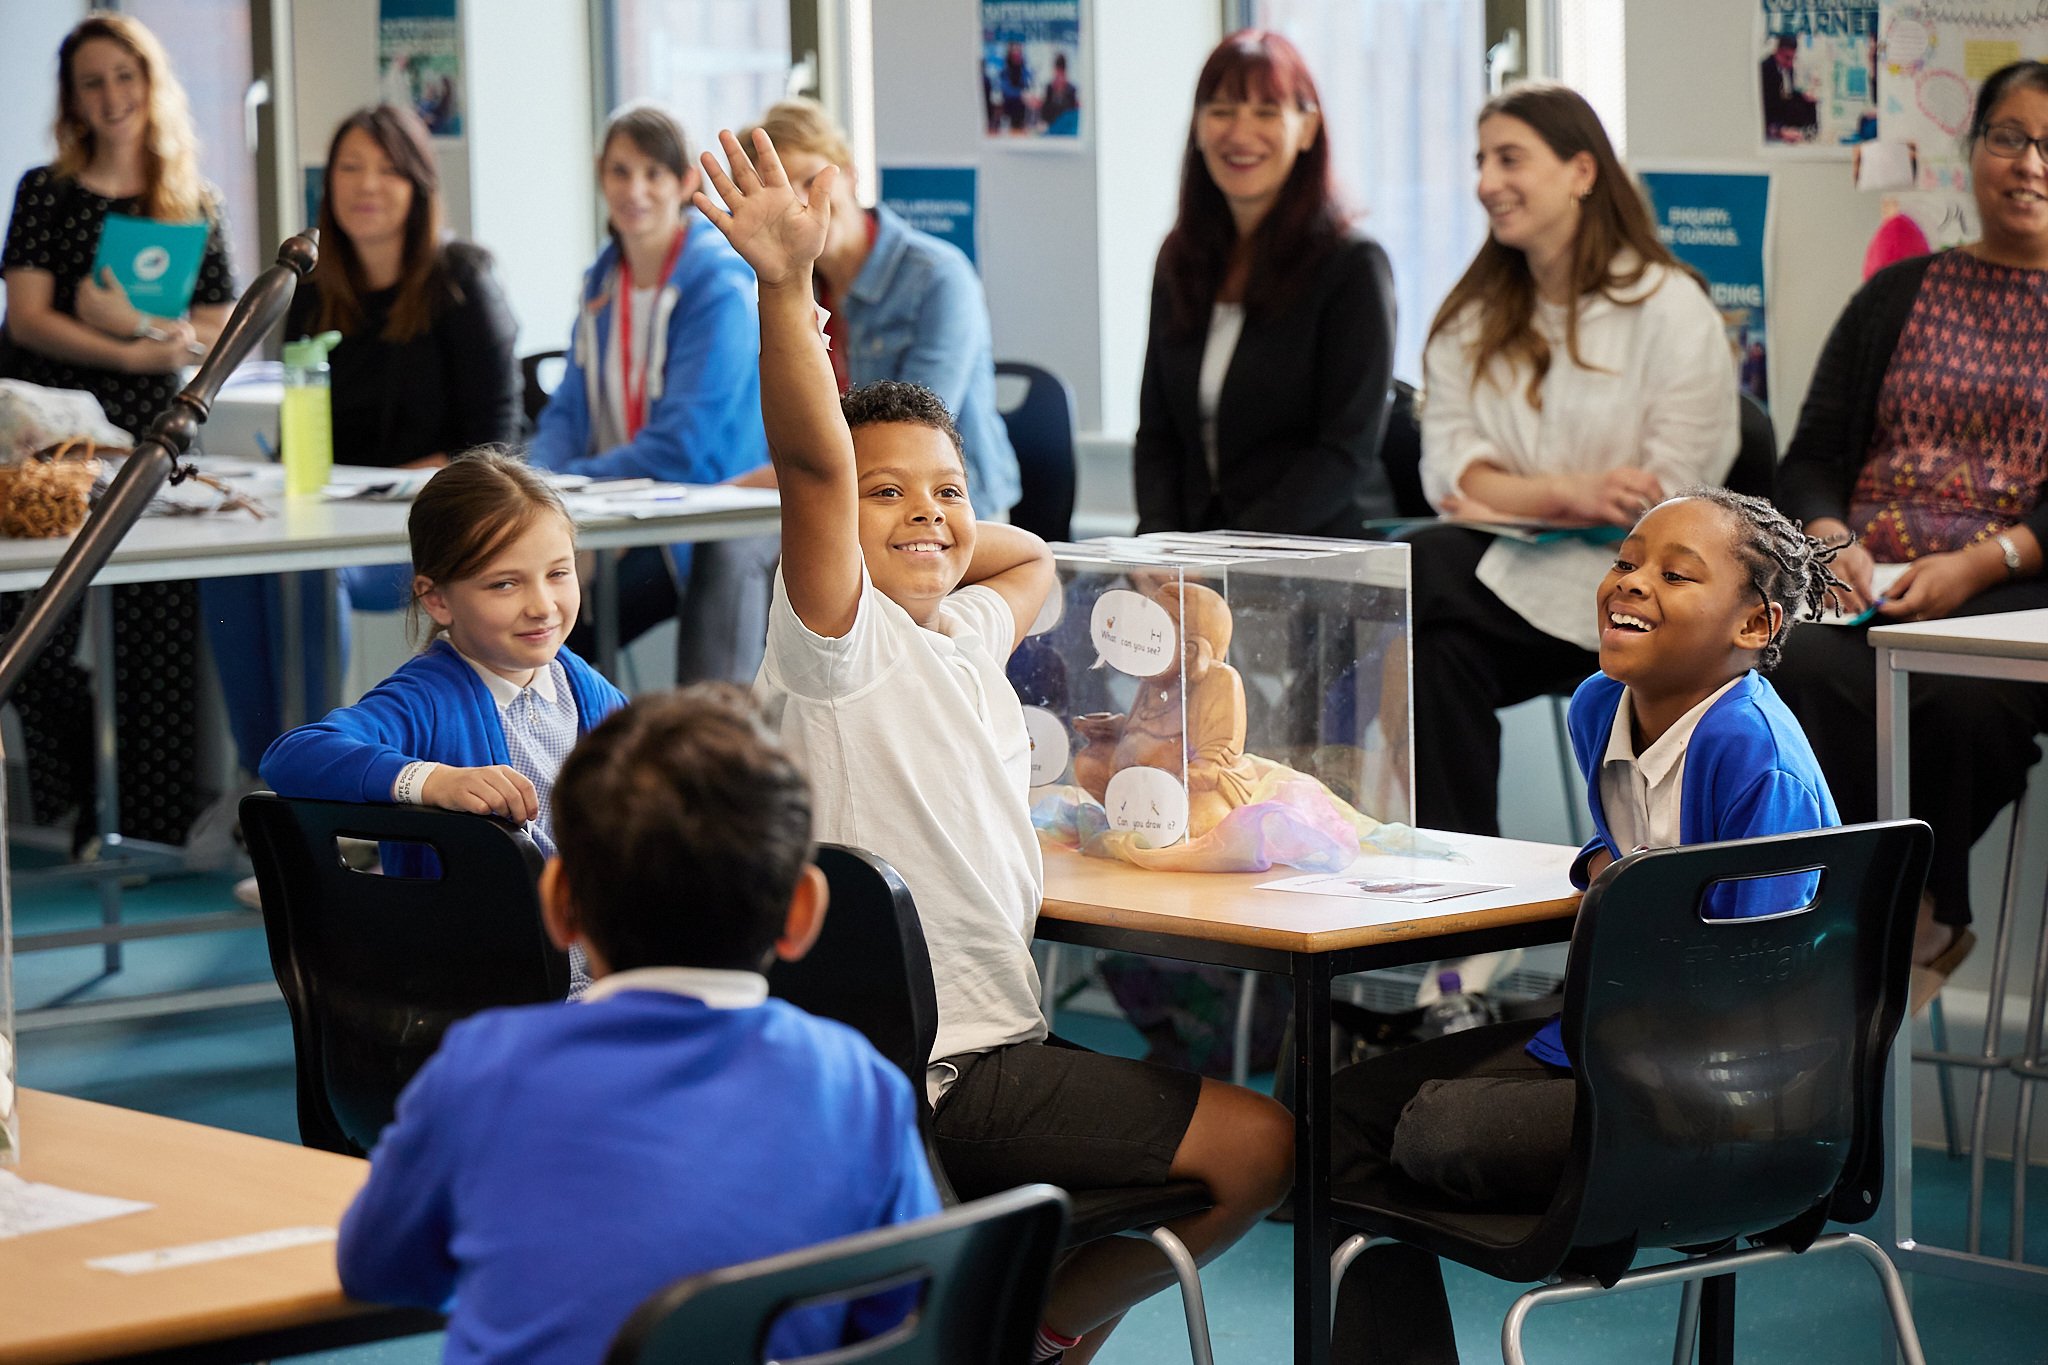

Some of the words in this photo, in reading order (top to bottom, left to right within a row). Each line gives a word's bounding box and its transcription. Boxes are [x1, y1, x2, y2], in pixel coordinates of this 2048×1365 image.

[1102, 630, 1116, 643] What
[1121, 639, 1132, 648] can
[1134, 643, 1145, 653] you
[1147, 646, 1161, 656] see?
[1117, 816, 1129, 826] Can
[1133, 820, 1144, 831] you
[1145, 818, 1161, 829] draw
